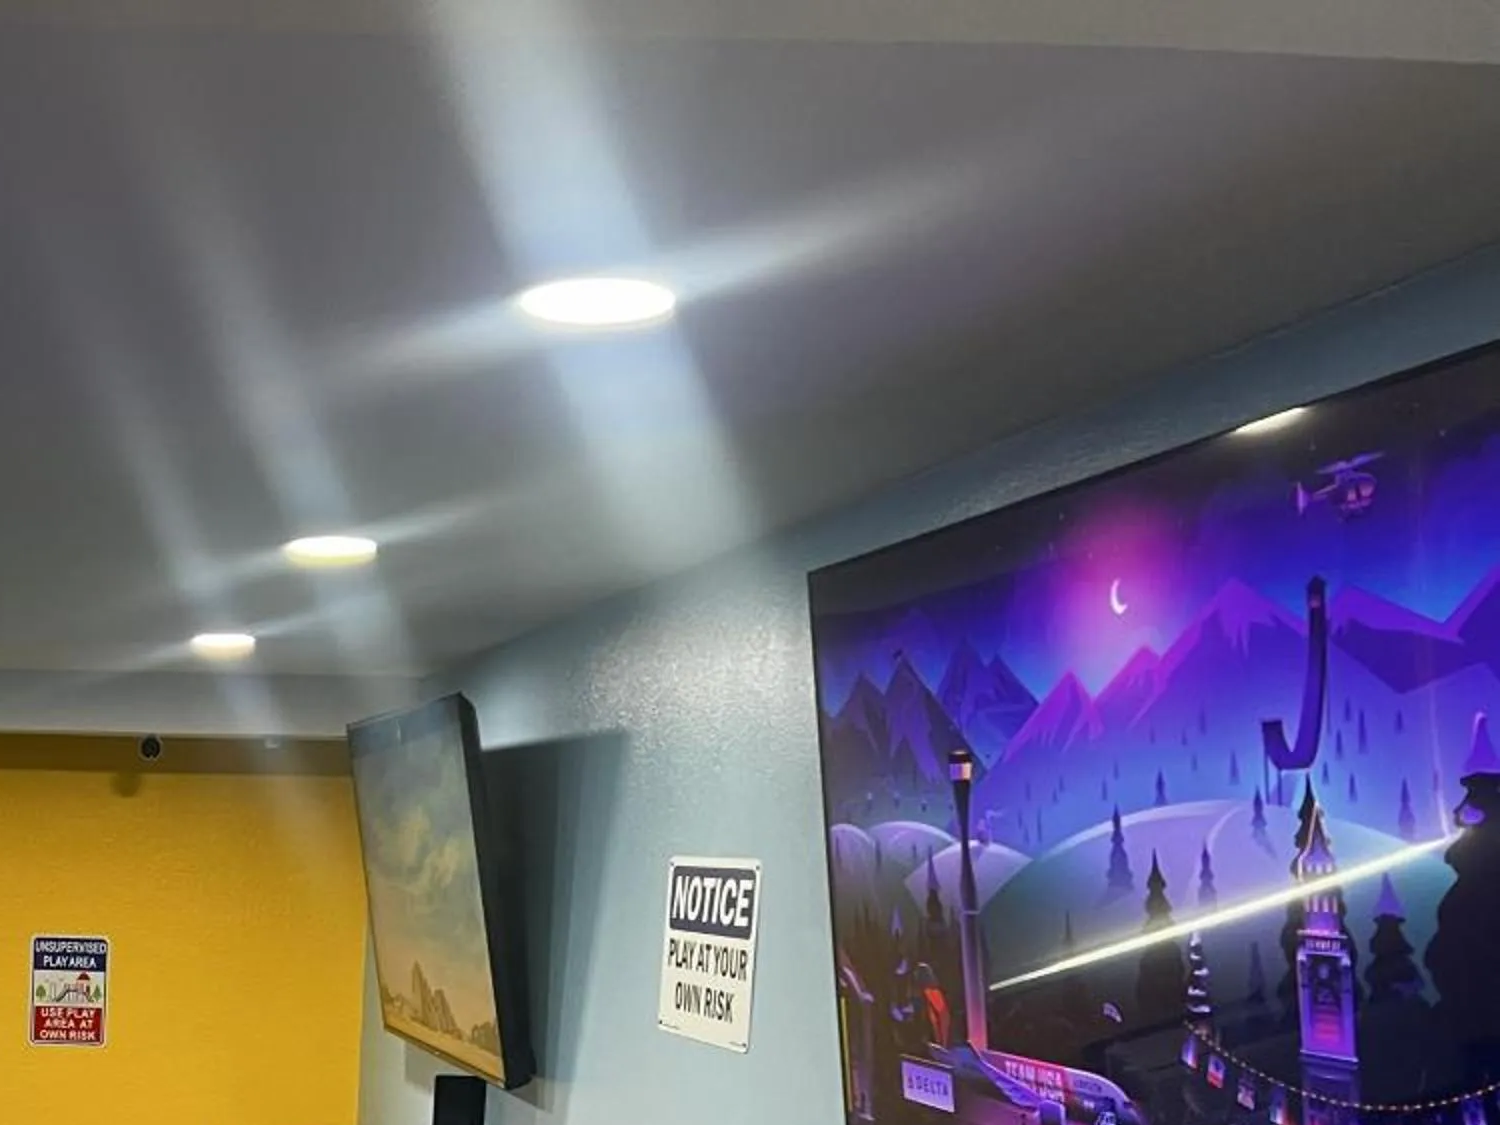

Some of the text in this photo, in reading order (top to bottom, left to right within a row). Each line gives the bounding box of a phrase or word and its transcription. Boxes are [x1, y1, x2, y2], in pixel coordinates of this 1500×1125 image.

[672, 875, 754, 927] NOTICE
[36, 941, 106, 954] UNSUPERVISED
[43, 955, 97, 968] PLAY AREA
[668, 938, 748, 981] PLAY AT YOUR
[675, 982, 734, 1024] OWN RISK
[41, 1007, 96, 1019] USE PLAY
[44, 1018, 93, 1029] AREA AT
[40, 1029, 95, 1041] OWN RISK
